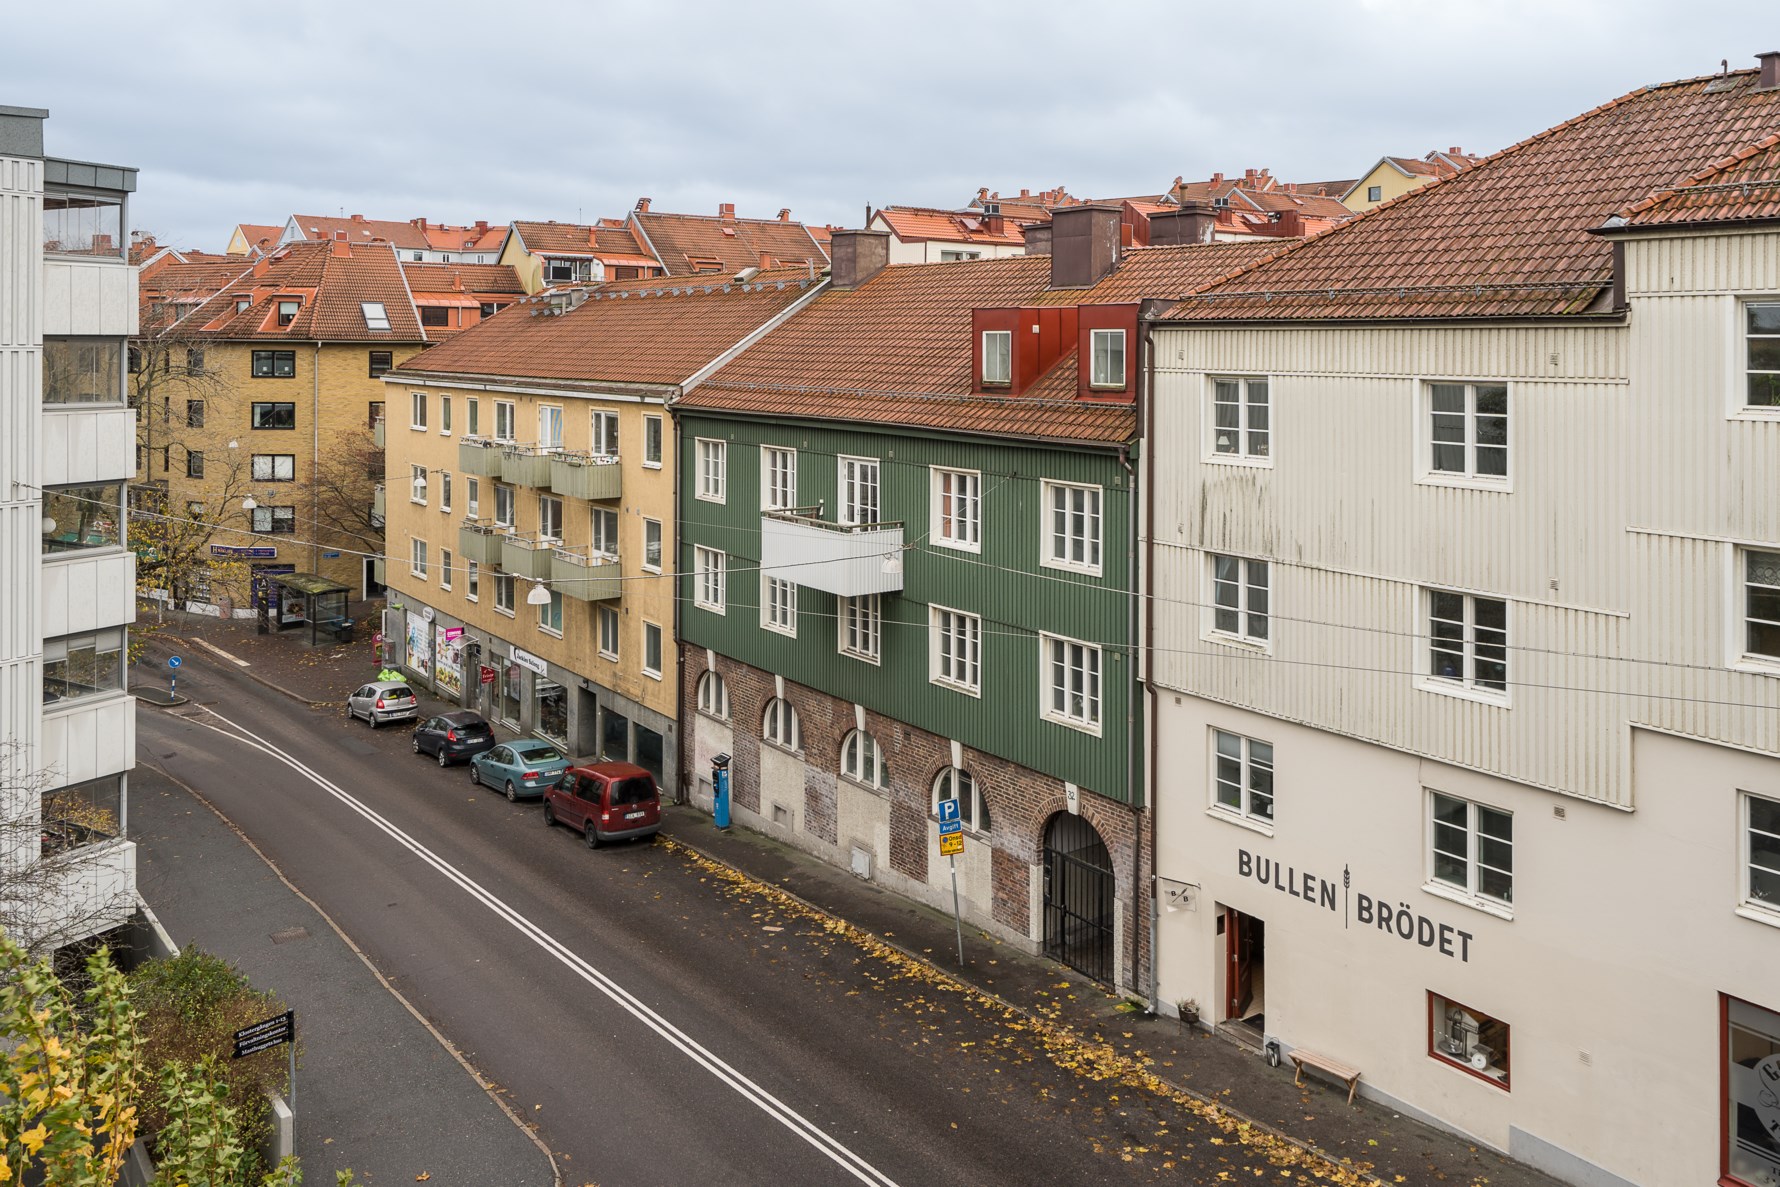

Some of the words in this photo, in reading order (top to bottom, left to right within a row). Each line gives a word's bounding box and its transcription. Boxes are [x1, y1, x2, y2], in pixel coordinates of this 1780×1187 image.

[942, 823, 959, 832] Avgift
[944, 801, 955, 820] P
[1238, 848, 1336, 911] BULLEN
[1358, 892, 1473, 963] BRÖDET
